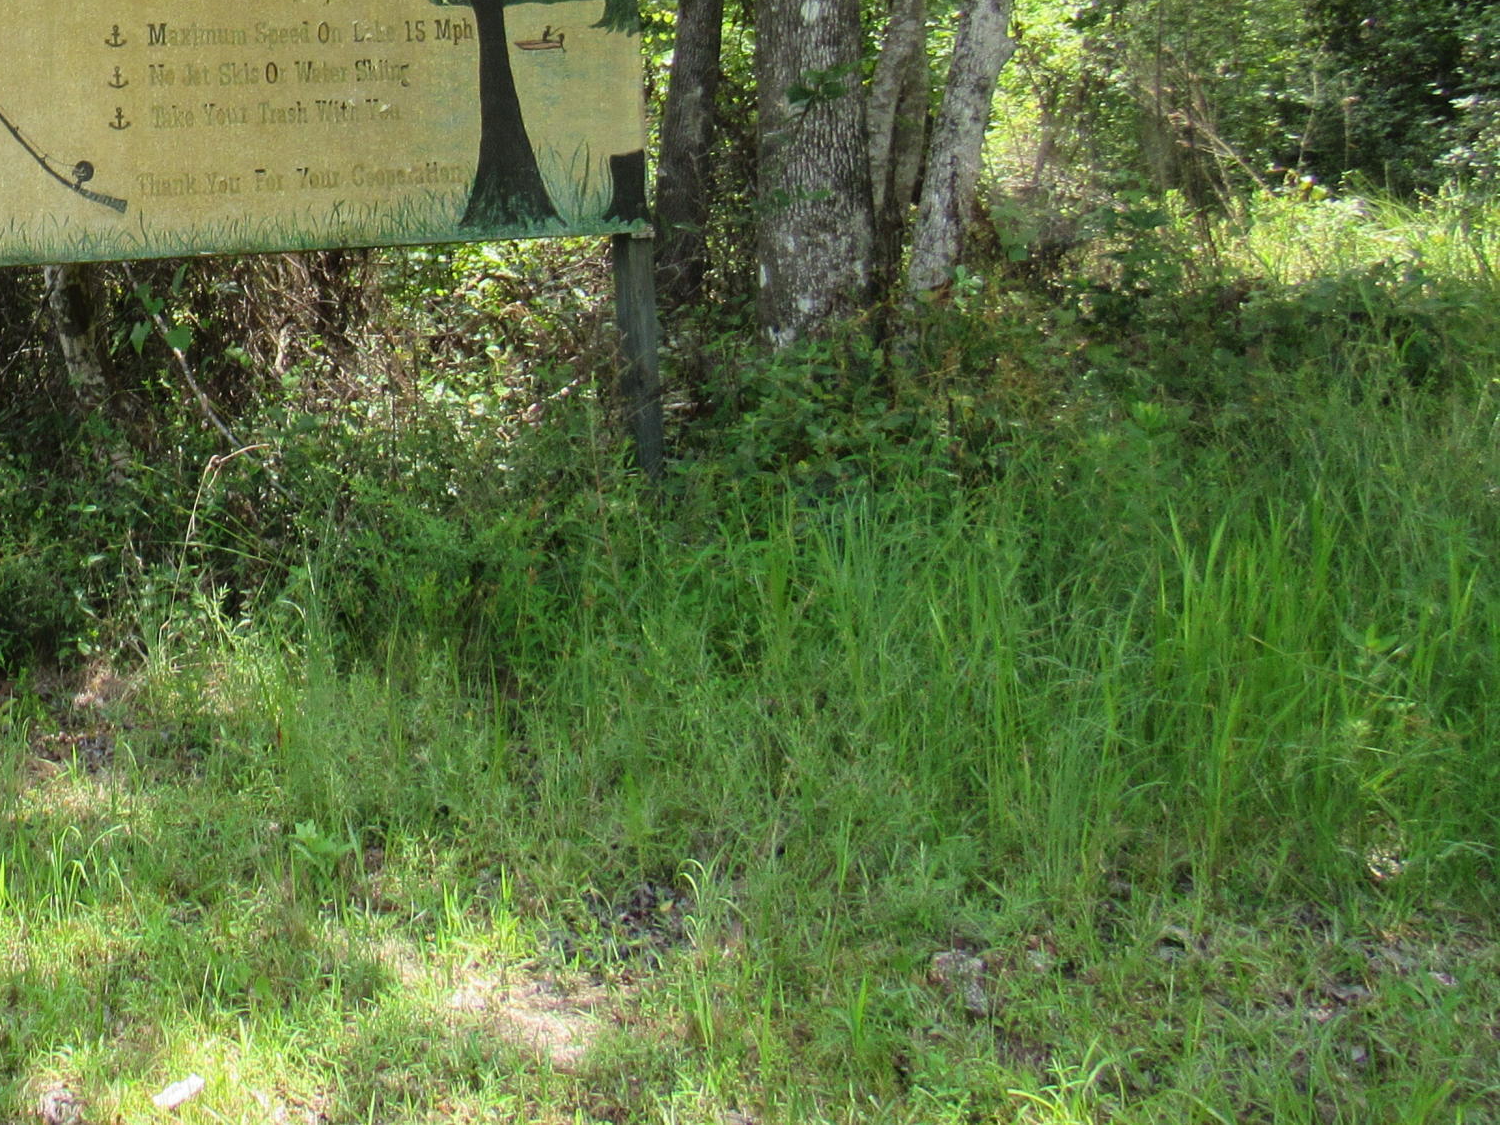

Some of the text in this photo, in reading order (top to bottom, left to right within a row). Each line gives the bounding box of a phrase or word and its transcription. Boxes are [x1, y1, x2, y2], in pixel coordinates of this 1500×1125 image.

[148, 23, 247, 47] Maximum
[255, 21, 310, 50] Speed
[318, 21, 342, 44] On
[405, 20, 426, 42] 15
[434, 18, 474, 45] Mph
[149, 59, 410, 87] No Jet Skis Or Water Skiing
[152, 105, 194, 128] Take
[205, 103, 248, 125] Your
[259, 101, 308, 124] Trash
[205, 172, 241, 195] You
[254, 169, 284, 192] For
